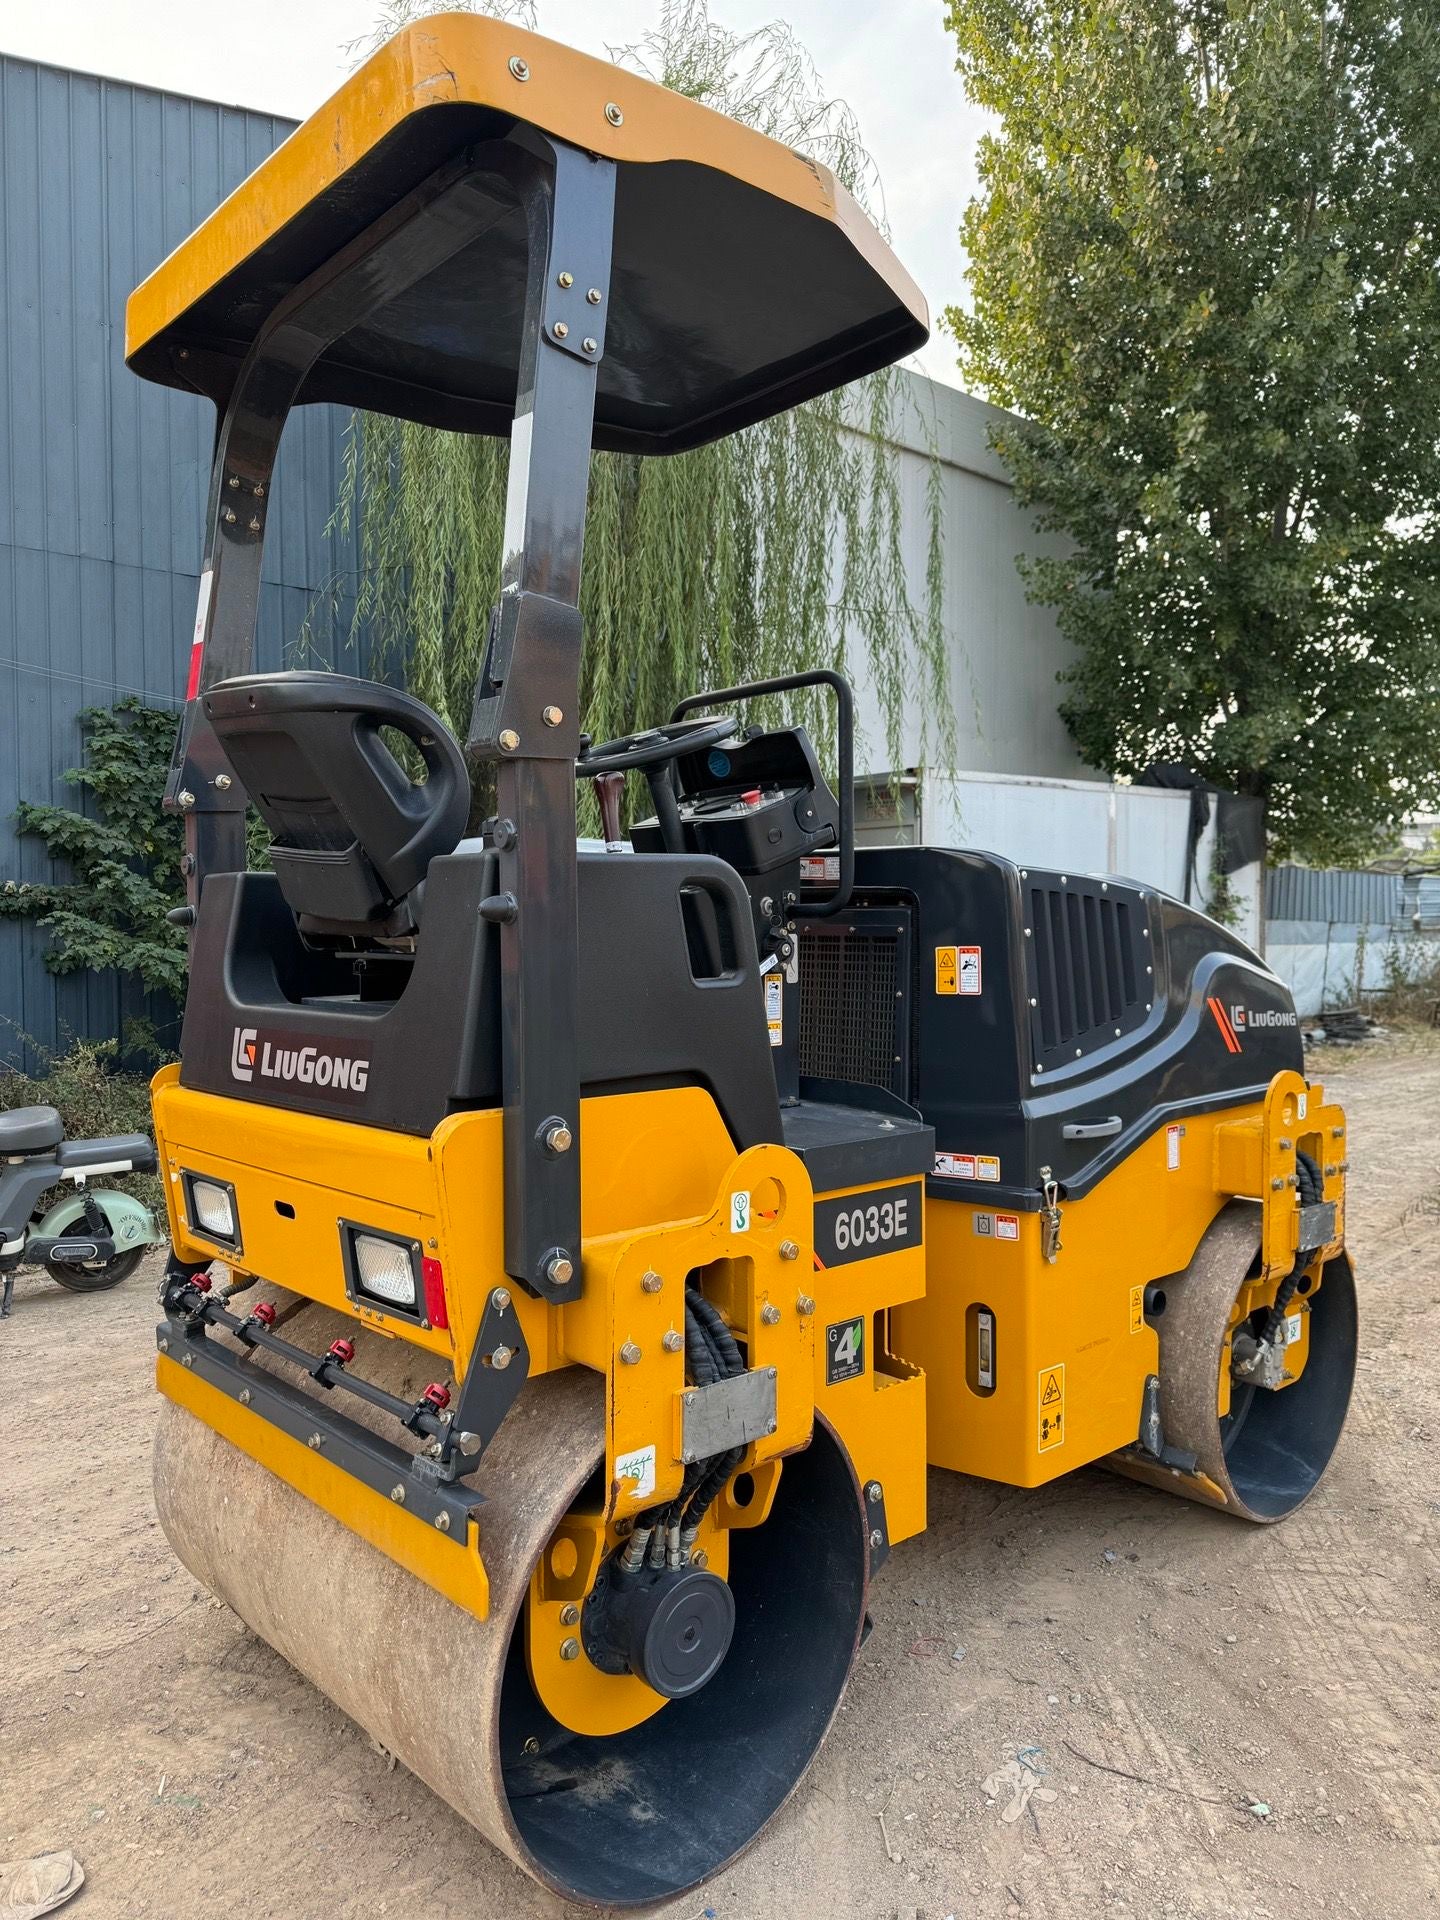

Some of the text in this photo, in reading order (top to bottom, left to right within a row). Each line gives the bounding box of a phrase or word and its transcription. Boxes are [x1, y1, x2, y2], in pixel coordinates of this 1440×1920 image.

[835, 1198, 908, 1251] 6033E
[829, 1326, 857, 1365] G 4
